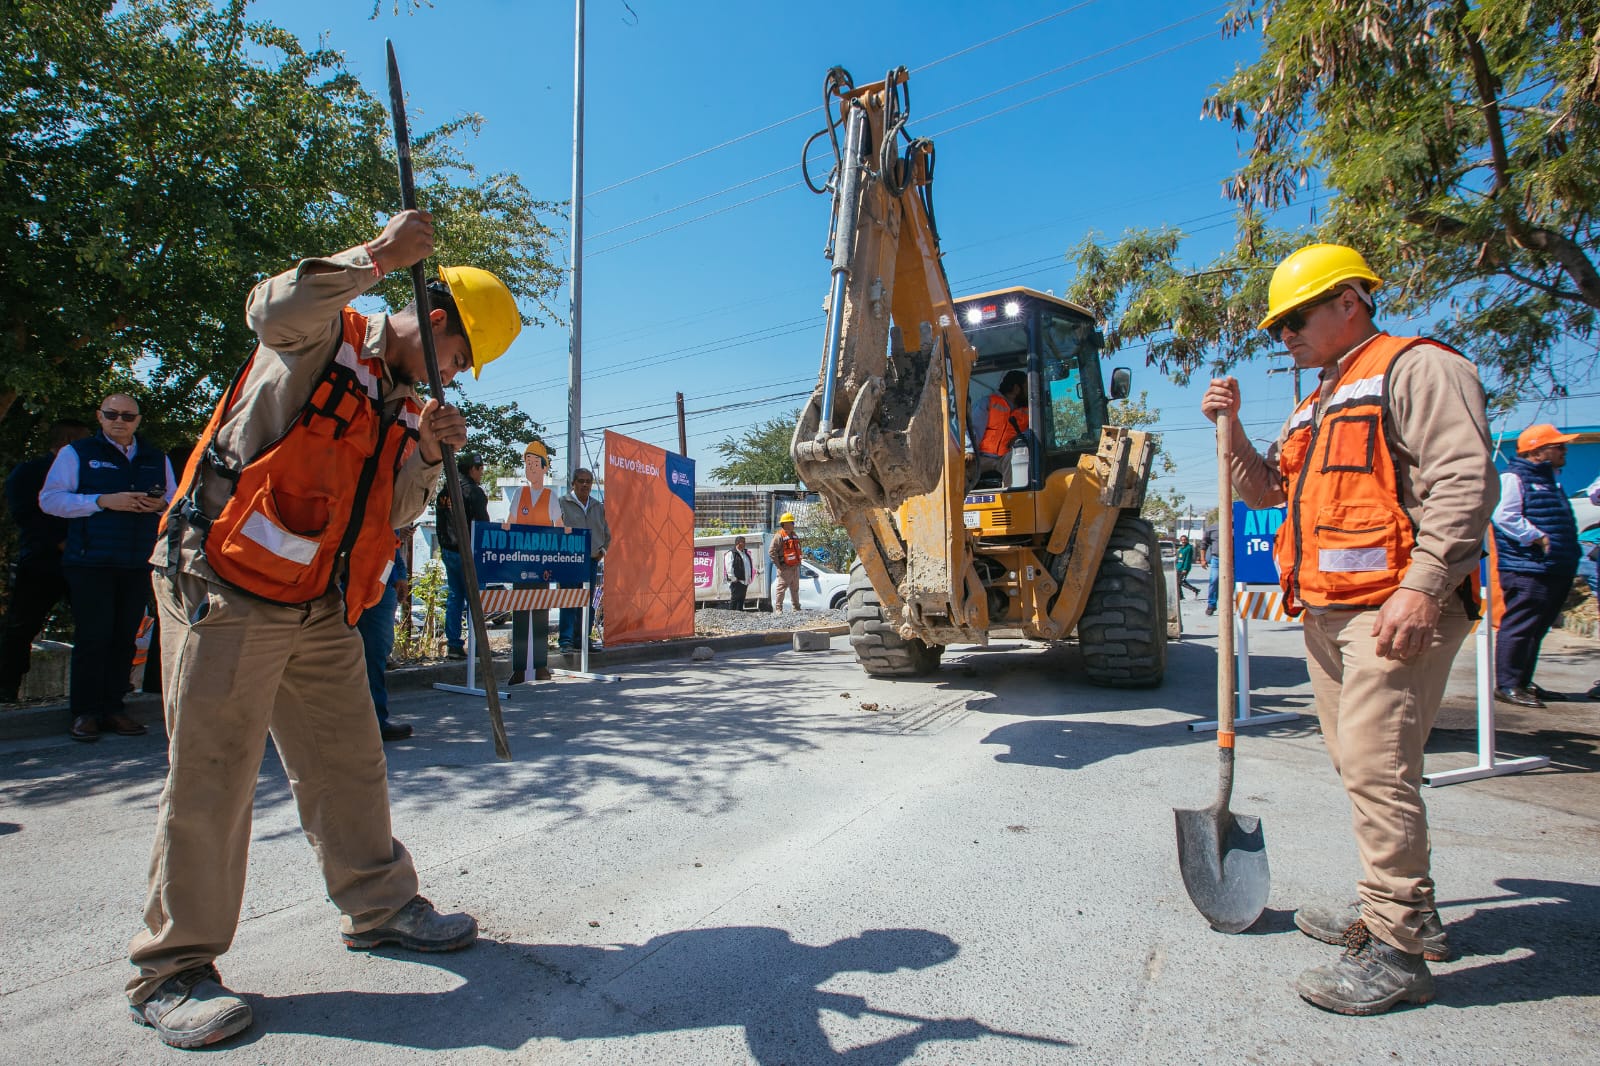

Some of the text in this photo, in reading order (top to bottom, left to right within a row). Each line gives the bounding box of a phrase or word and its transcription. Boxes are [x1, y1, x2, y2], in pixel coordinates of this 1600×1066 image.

[609, 453, 660, 477] NUEVO LEÓN
[1244, 508, 1283, 536] AYD
[481, 529, 586, 554] AYD TRABAJA AQUÍ
[1247, 538, 1270, 555] ¡Te
[482, 551, 585, 565] ¡Te pedimos paciencia!
